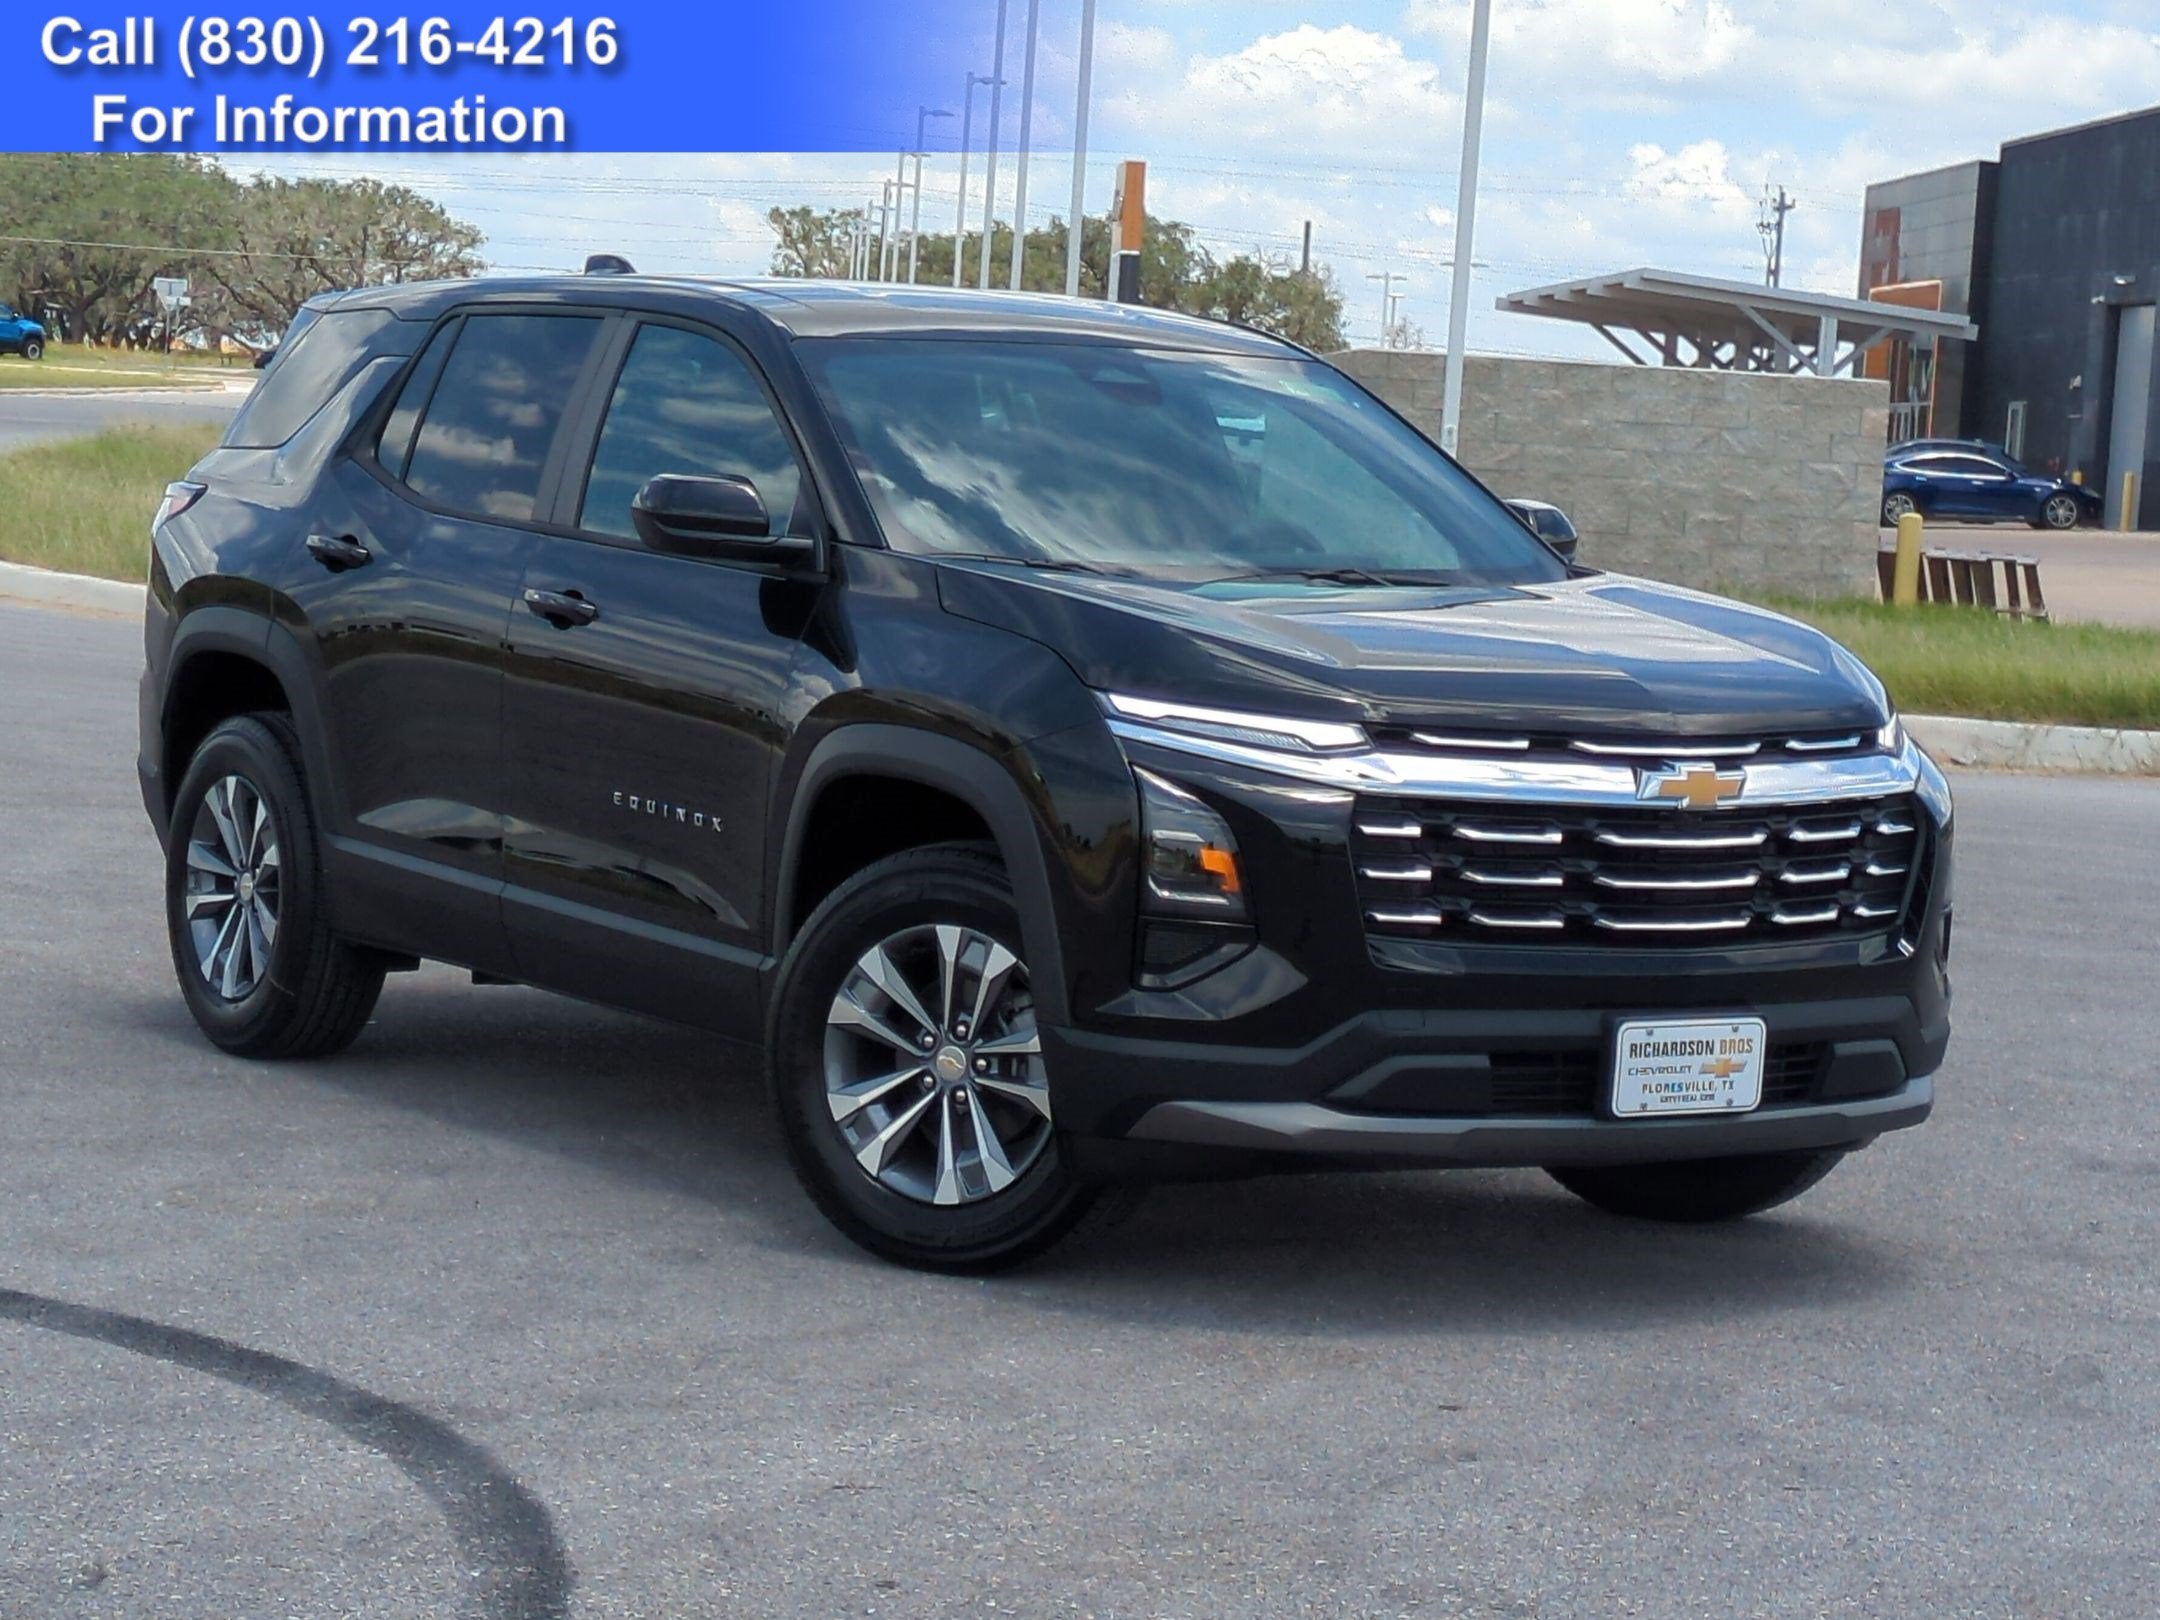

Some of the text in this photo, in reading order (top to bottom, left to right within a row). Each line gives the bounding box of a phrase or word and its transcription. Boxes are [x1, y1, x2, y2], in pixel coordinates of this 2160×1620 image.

[613, 791, 722, 832] EQUINOX
[1629, 1038, 1753, 1059] RICHARDSON BROS
[1628, 1065, 1692, 1076] CHEVROLET
[1722, 1081, 1734, 1091] TX
